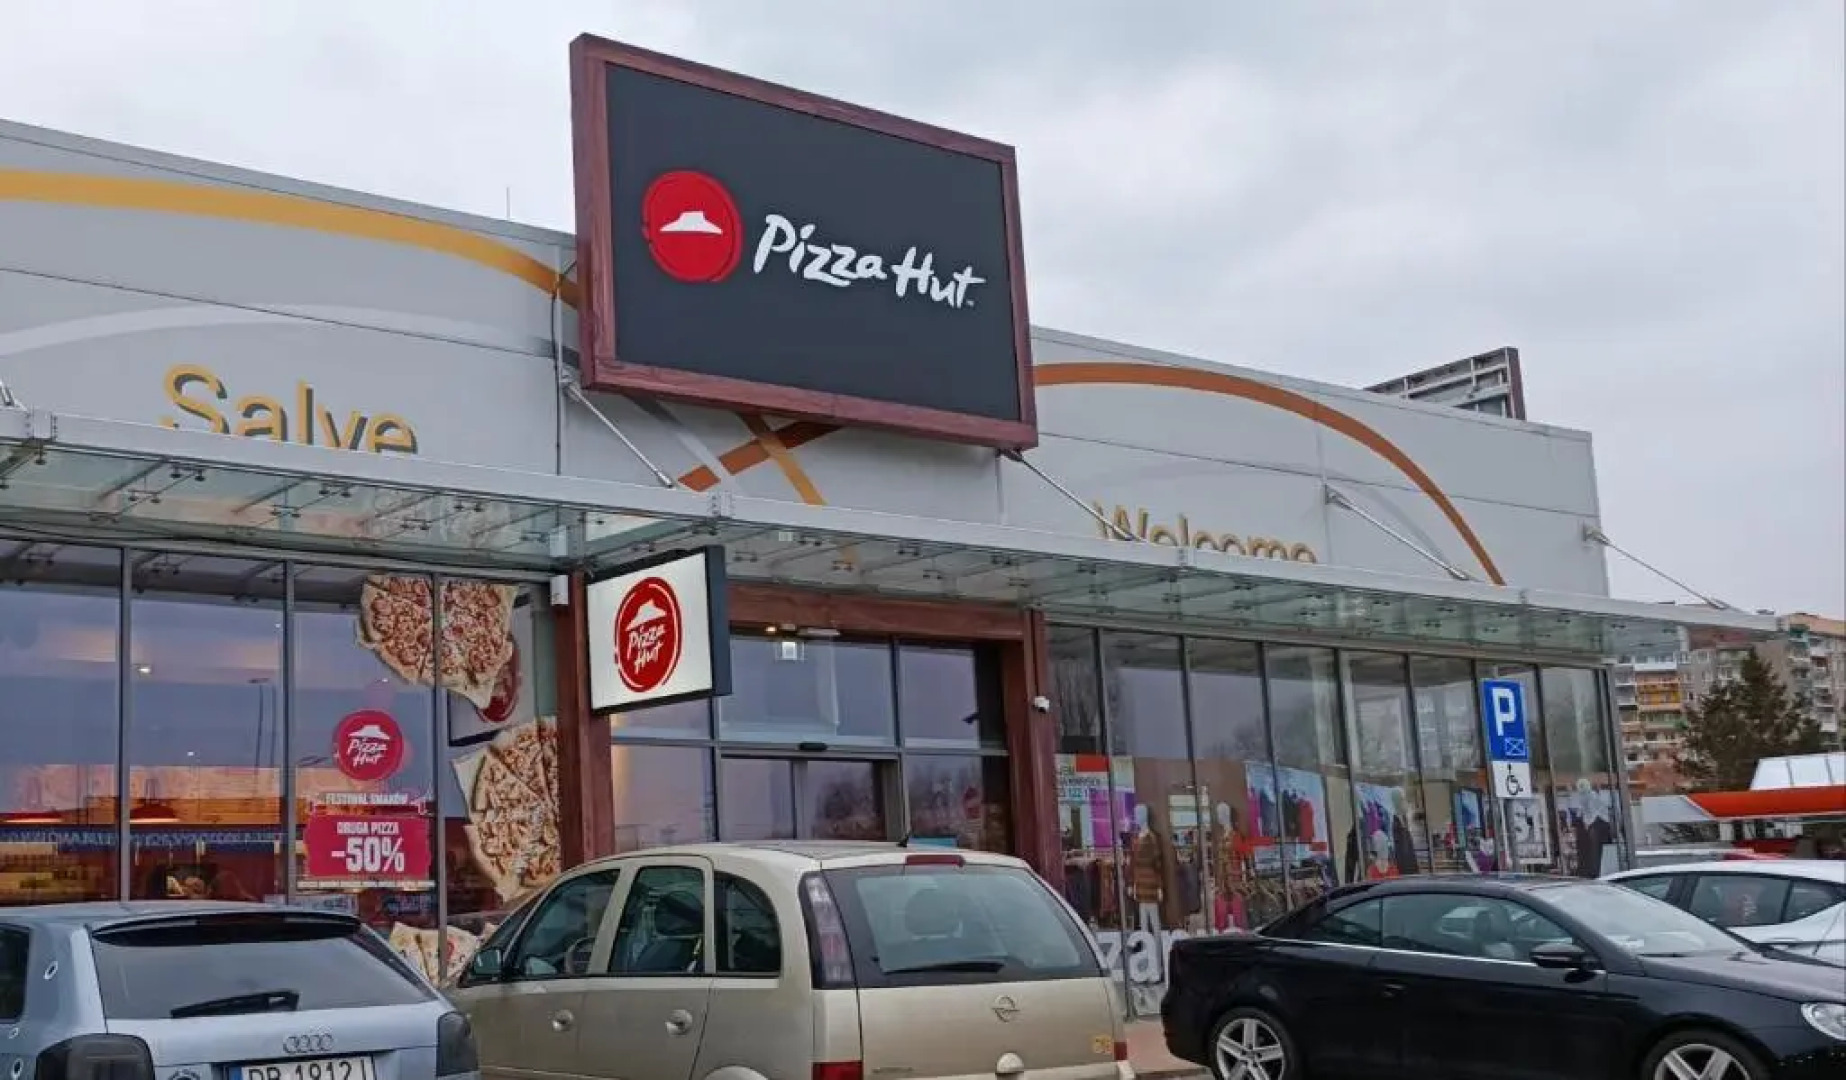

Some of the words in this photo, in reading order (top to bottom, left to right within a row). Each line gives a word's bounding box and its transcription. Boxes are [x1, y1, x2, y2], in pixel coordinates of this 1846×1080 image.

[753, 214, 887, 287] Pizza
[159, 363, 419, 454] Salve
[627, 623, 666, 661] Pizza
[634, 641, 664, 675] Hut
[1492, 687, 1517, 737] P
[346, 738, 388, 756] Pizza
[352, 753, 384, 767] Hut
[370, 821, 400, 835] PIZZA
[331, 836, 405, 872] -50%
